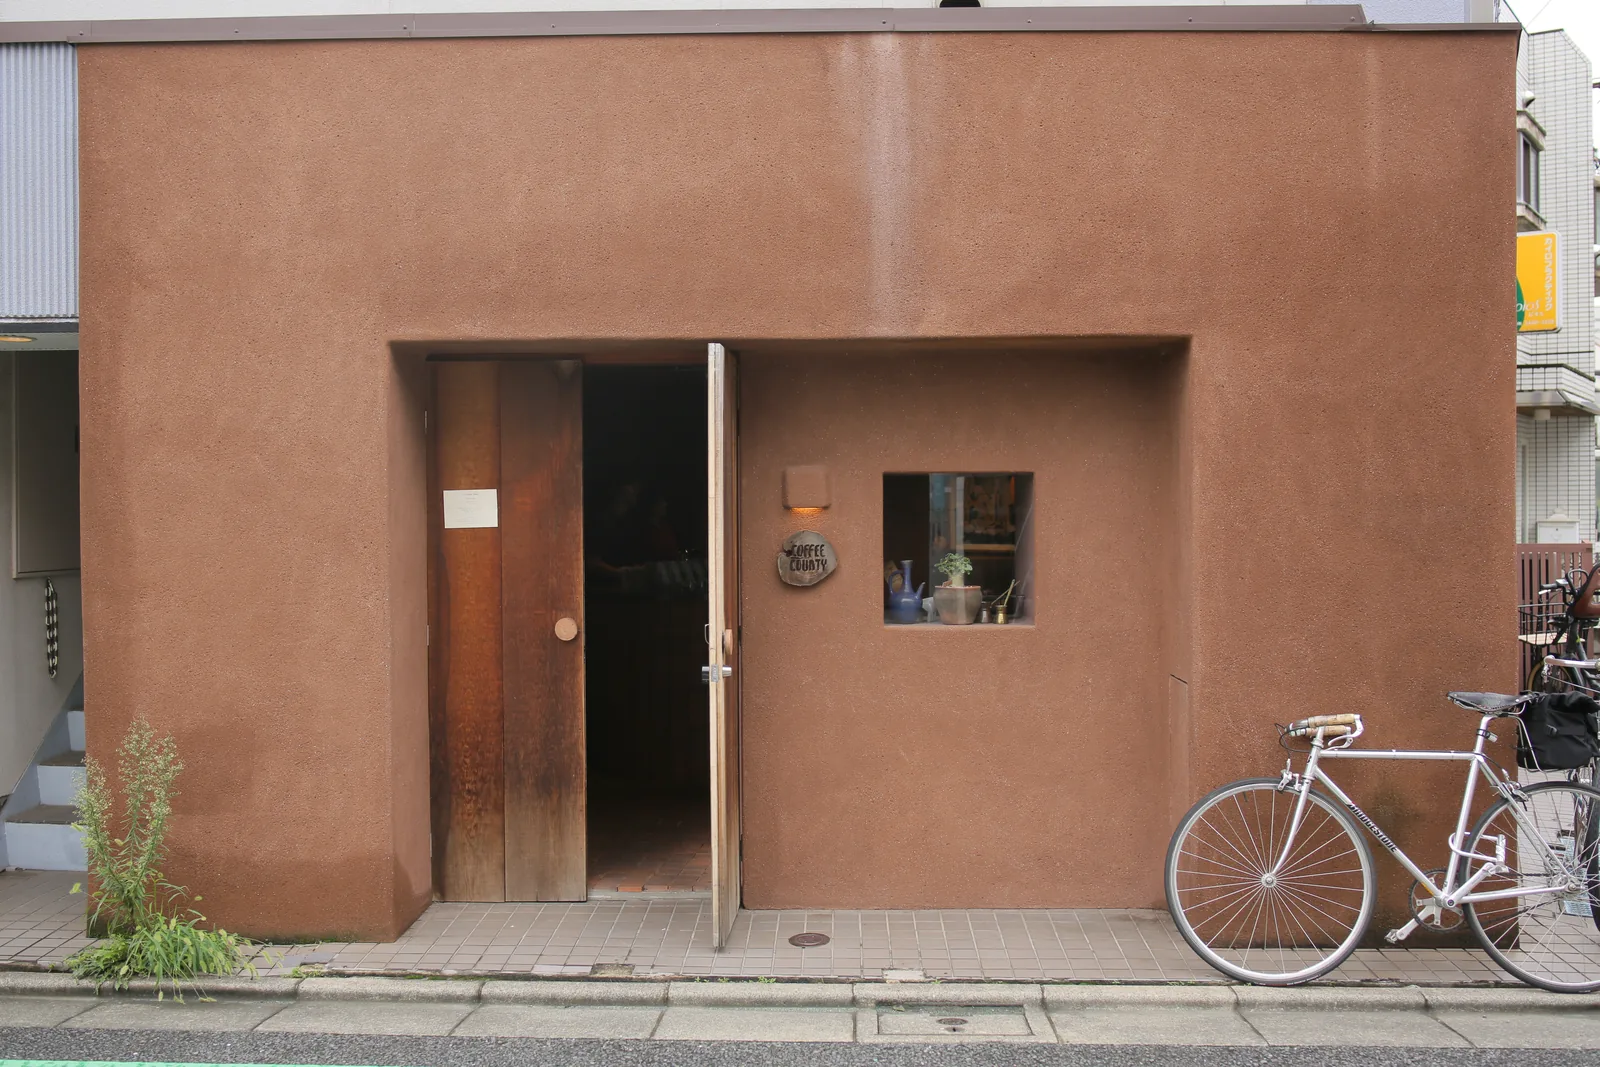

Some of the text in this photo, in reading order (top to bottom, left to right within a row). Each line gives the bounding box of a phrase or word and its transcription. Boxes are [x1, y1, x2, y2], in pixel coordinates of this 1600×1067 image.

[791, 543, 826, 558] COFFEE
[789, 558, 828, 572] COUNTY
[1347, 803, 1398, 853] BRIDGESTONE
